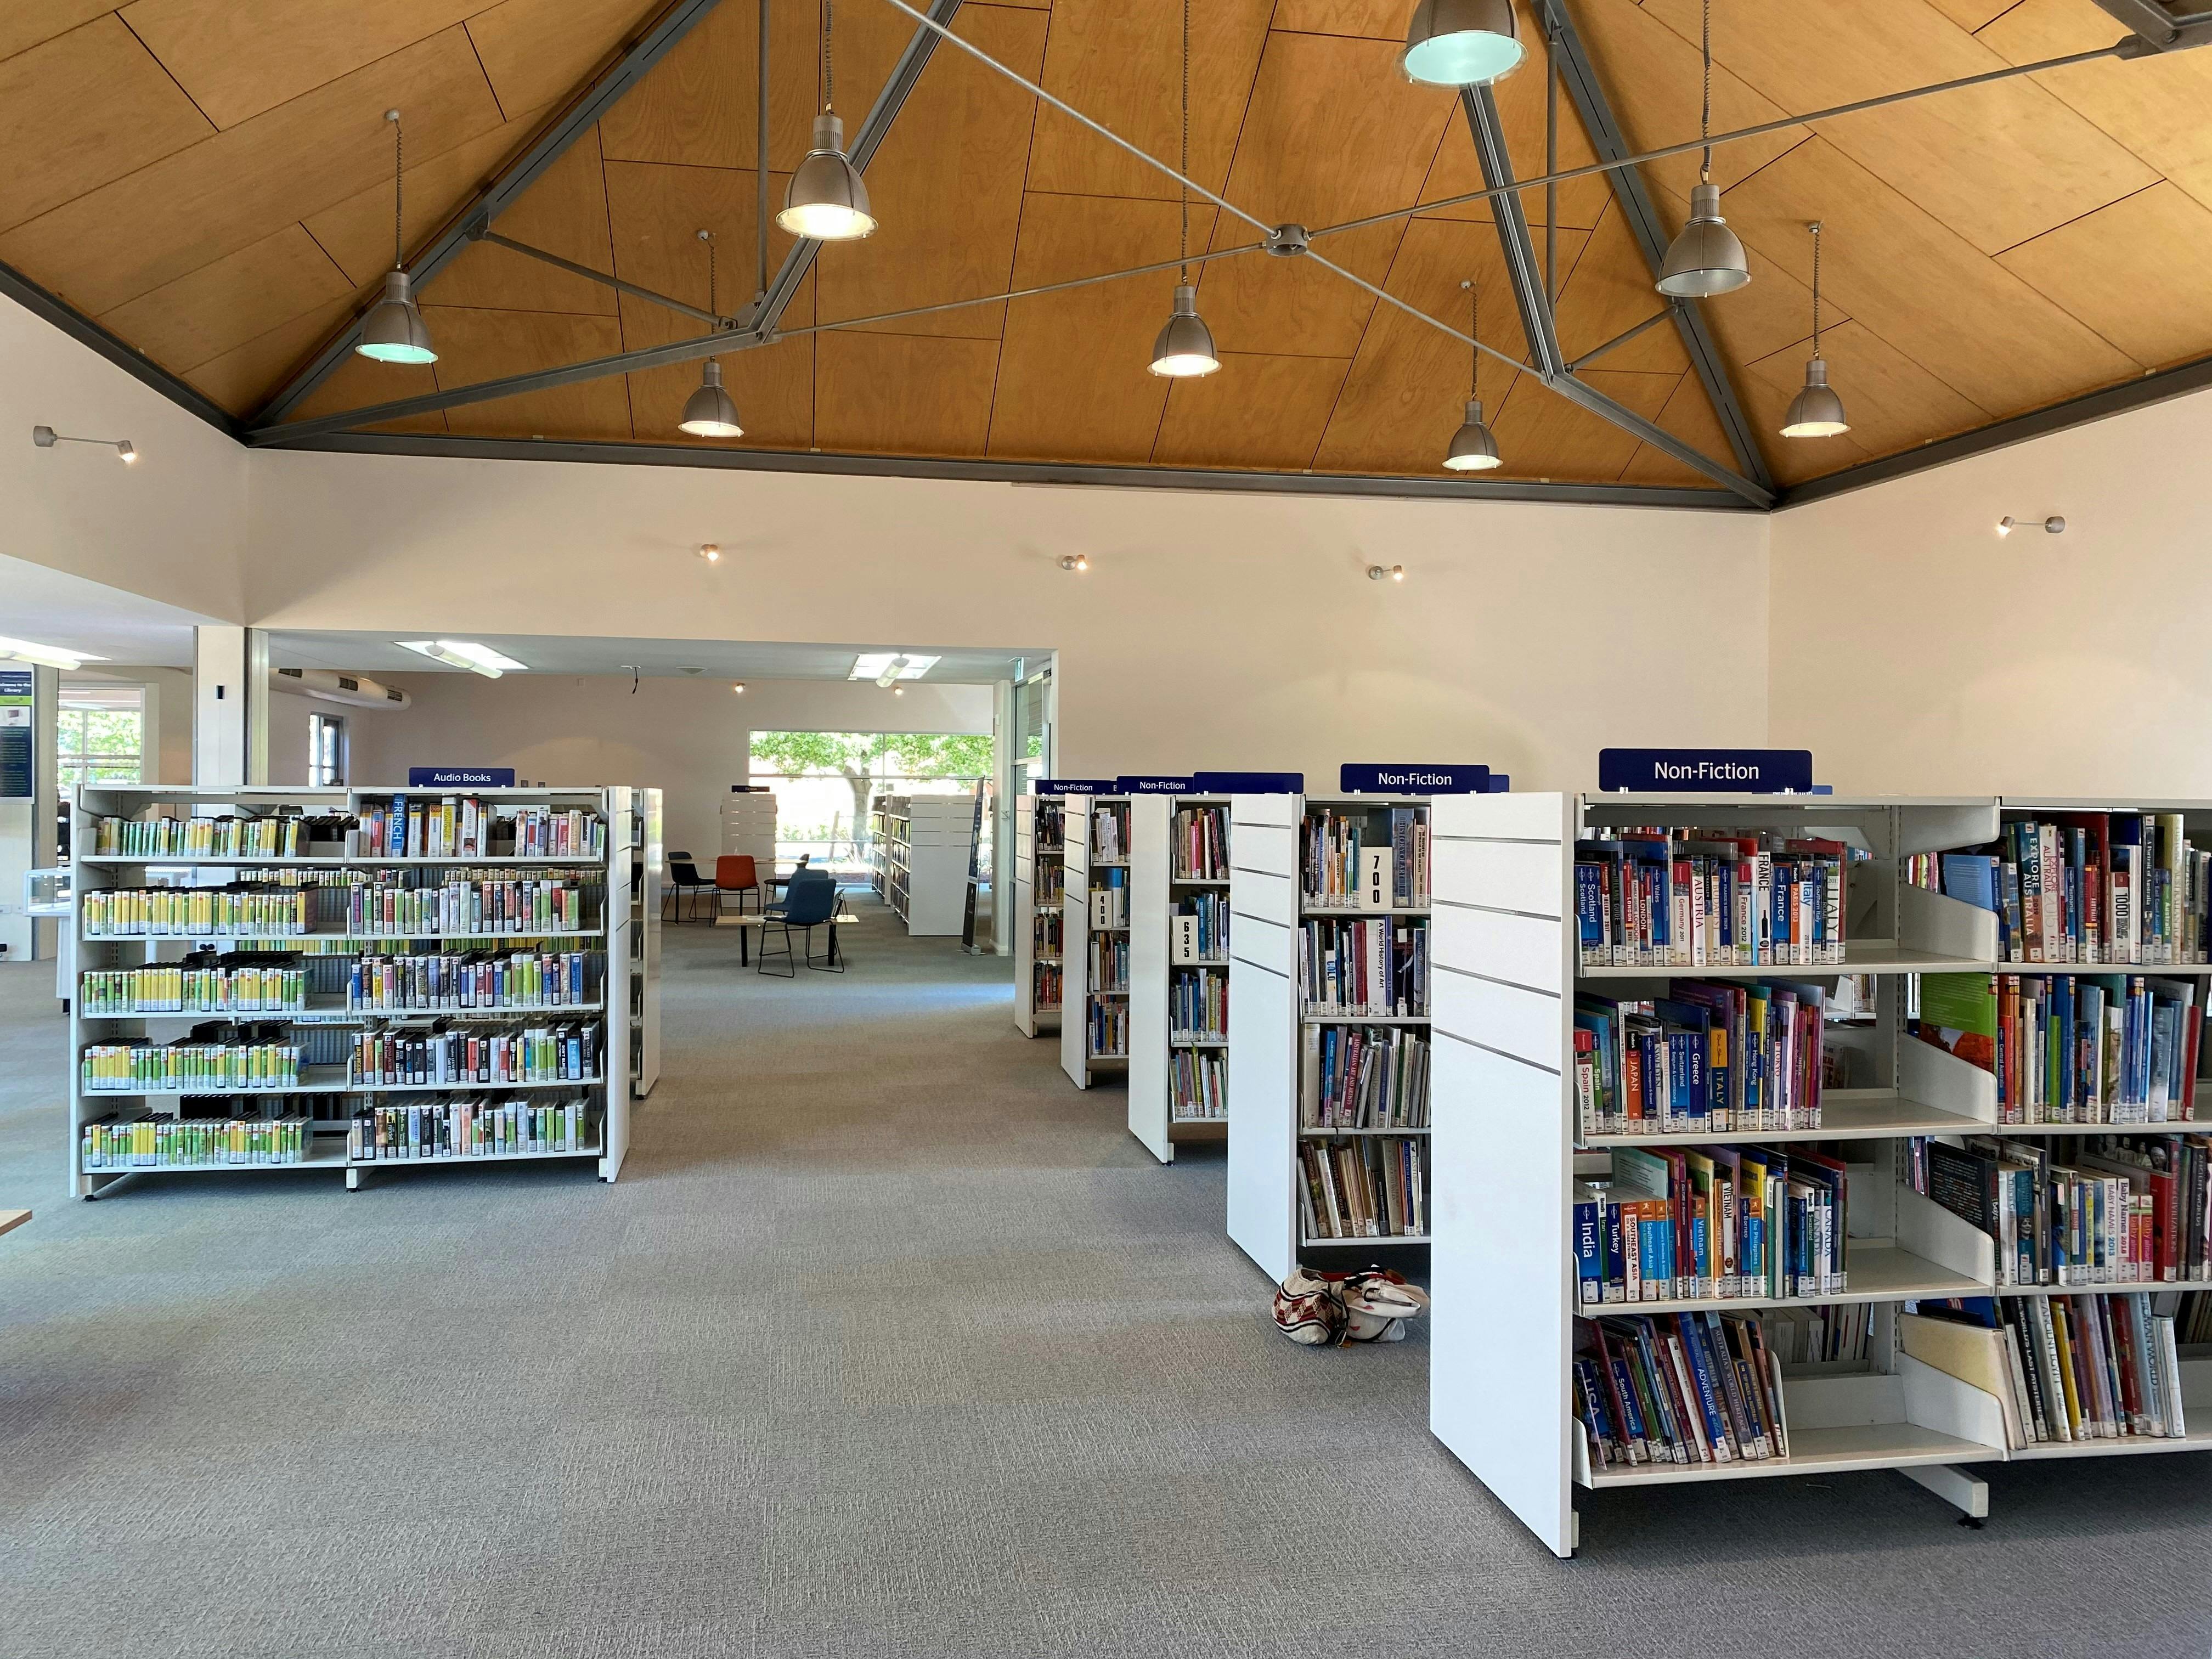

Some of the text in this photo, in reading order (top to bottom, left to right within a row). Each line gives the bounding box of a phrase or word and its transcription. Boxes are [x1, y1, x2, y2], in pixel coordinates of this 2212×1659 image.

[433, 773, 491, 782] Audio Books
[1139, 781, 1186, 789] Non-Fiction
[1378, 772, 1452, 785] Non-Fiction
[1655, 761, 1759, 780] Non-Fiction
[393, 802, 403, 839] FRENCH
[1759, 855, 1769, 891] FRANCE
[2030, 838, 2040, 888] EXPLORE
[1588, 884, 1596, 922] Scotland
[1695, 879, 1703, 928] AUSTRIA
[1778, 885, 1786, 922] France
[1801, 883, 1812, 906] Italy
[1827, 888, 1838, 933] ITALY
[2023, 873, 2034, 935] AUSTRALIA
[2115, 893, 2129, 917] 1000
[1630, 1060, 1639, 1091] JAPAN
[1724, 1187, 1732, 1219] VIETNAM
[2119, 1183, 2128, 1204] Baby
[1582, 1222, 1595, 1258] India
[1611, 1222, 1620, 1254] Turkey
[1703, 1351, 1719, 1387] AUSTRALIA'S
[1715, 1329, 1747, 1432] AUSTRALIA'S WORLD HERITAGE
[2147, 1345, 2158, 1386] WORLD
[1618, 1378, 1636, 1431] South America
[1697, 1369, 1716, 1416] ADVENTURE
